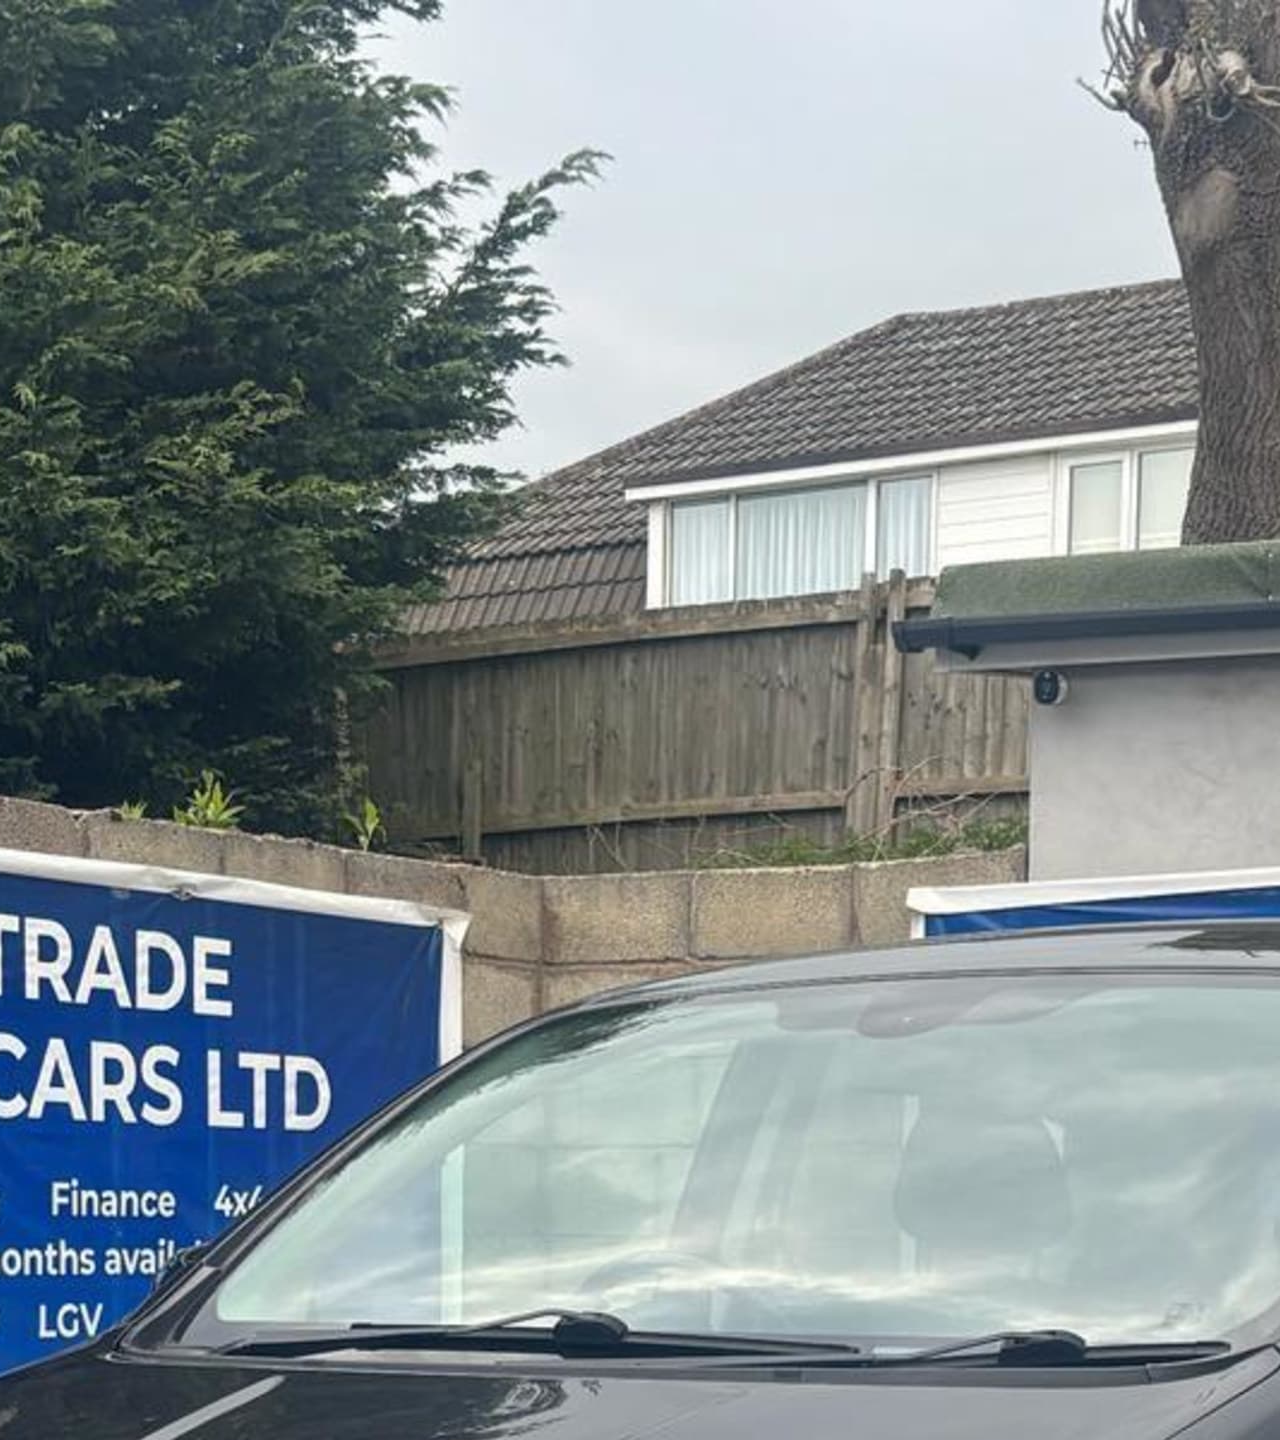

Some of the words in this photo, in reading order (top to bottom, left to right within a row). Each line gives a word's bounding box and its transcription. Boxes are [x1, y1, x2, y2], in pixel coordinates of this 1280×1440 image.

[207, 1049, 331, 1131] LTD
[52, 1179, 176, 1217] Finance
[39, 1303, 103, 1338] LGV
